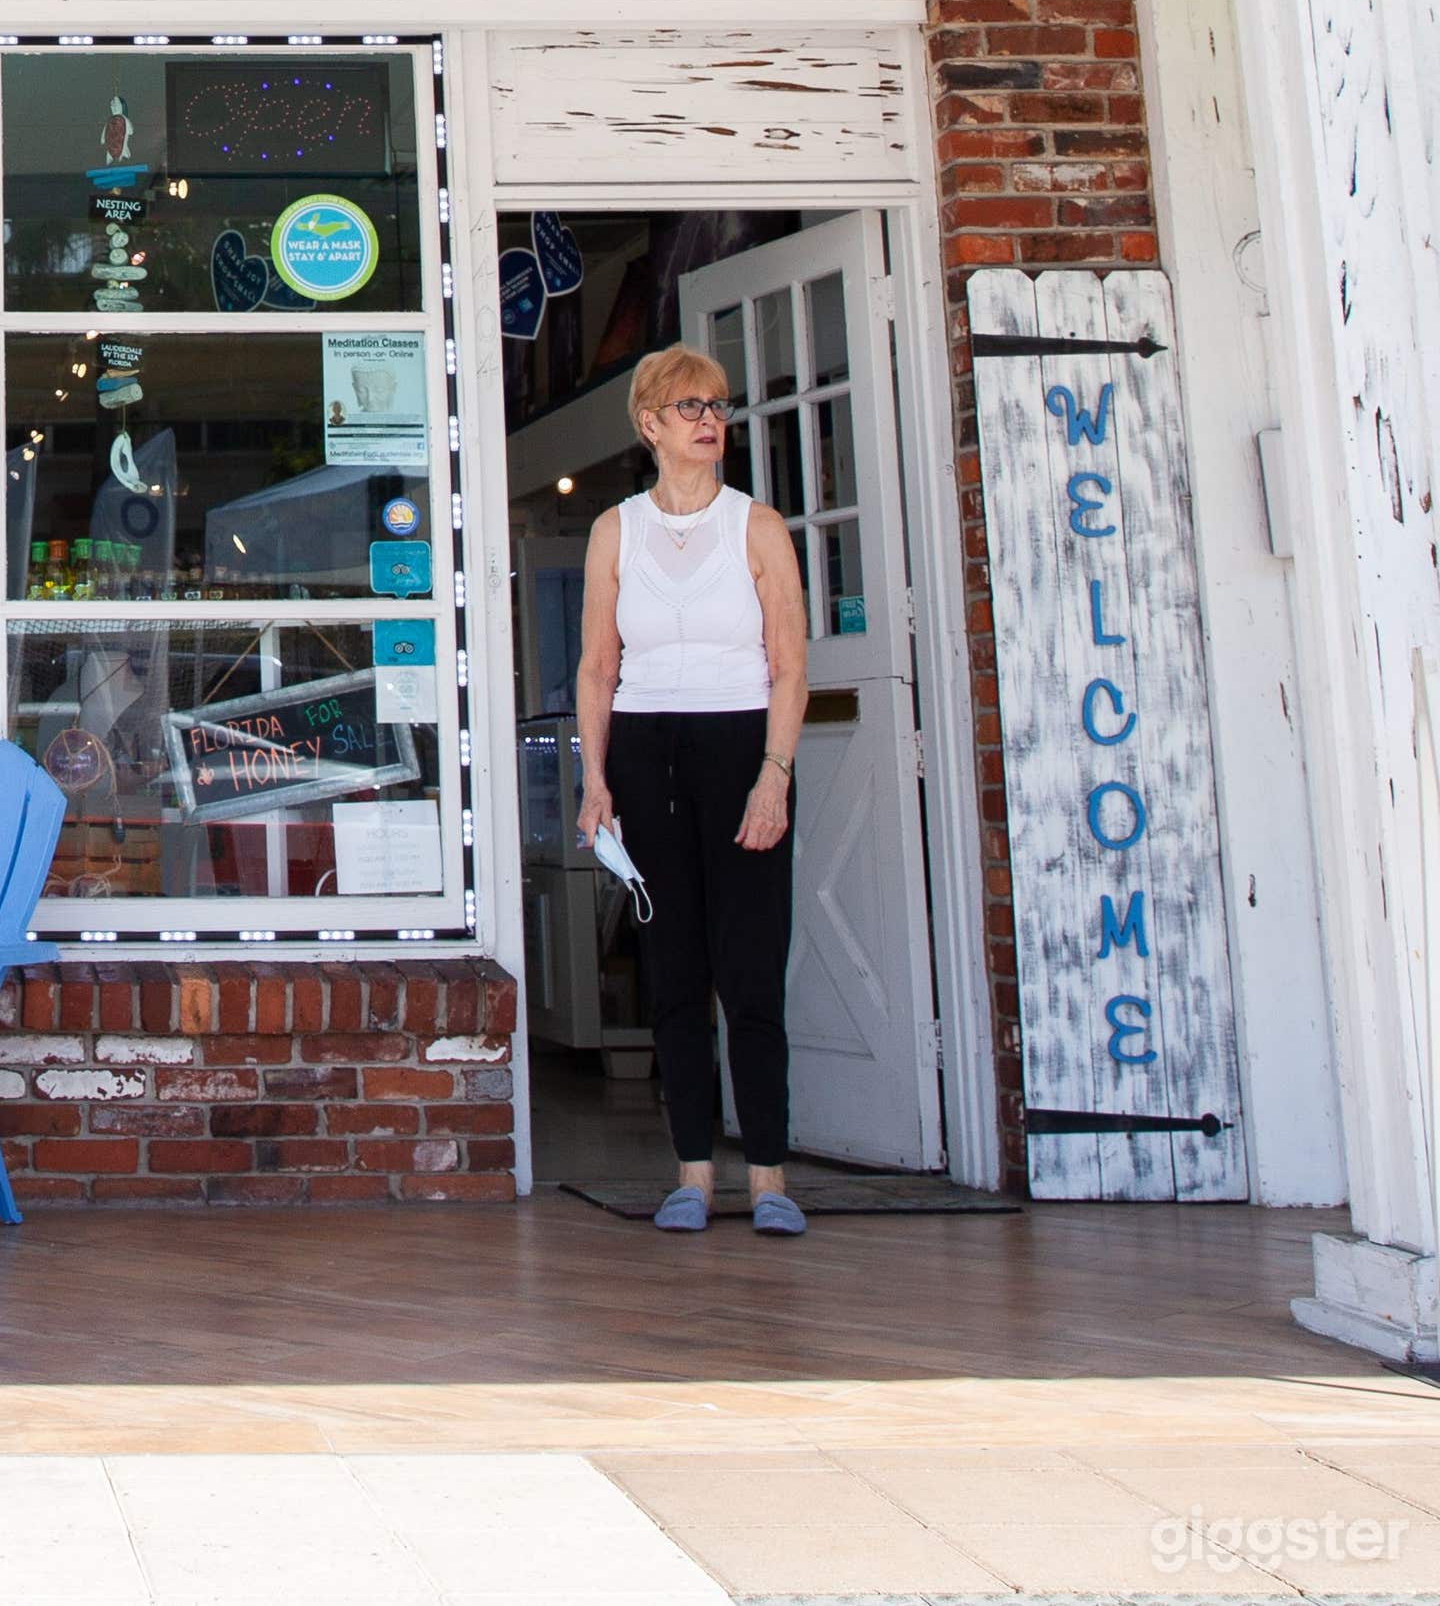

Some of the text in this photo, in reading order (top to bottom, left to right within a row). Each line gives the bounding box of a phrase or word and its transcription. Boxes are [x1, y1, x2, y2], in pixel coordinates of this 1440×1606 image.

[96, 198, 142, 212] NESTING
[104, 209, 132, 221] AREA
[288, 240, 361, 251] WEAR A MASK
[288, 251, 315, 262] STAY
[328, 251, 361, 262] APART
[327, 338, 419, 348] Meditation Classes
[100, 343, 143, 356] LAUDERDALE
[343, 350, 371, 359] person
[388, 349, 415, 358] Online
[108, 358, 133, 368] FLORIDA
[190, 699, 343, 755] FLORIDA FOR
[1046, 384, 1158, 1067] WELCOME
[228, 735, 321, 792] HONEY
